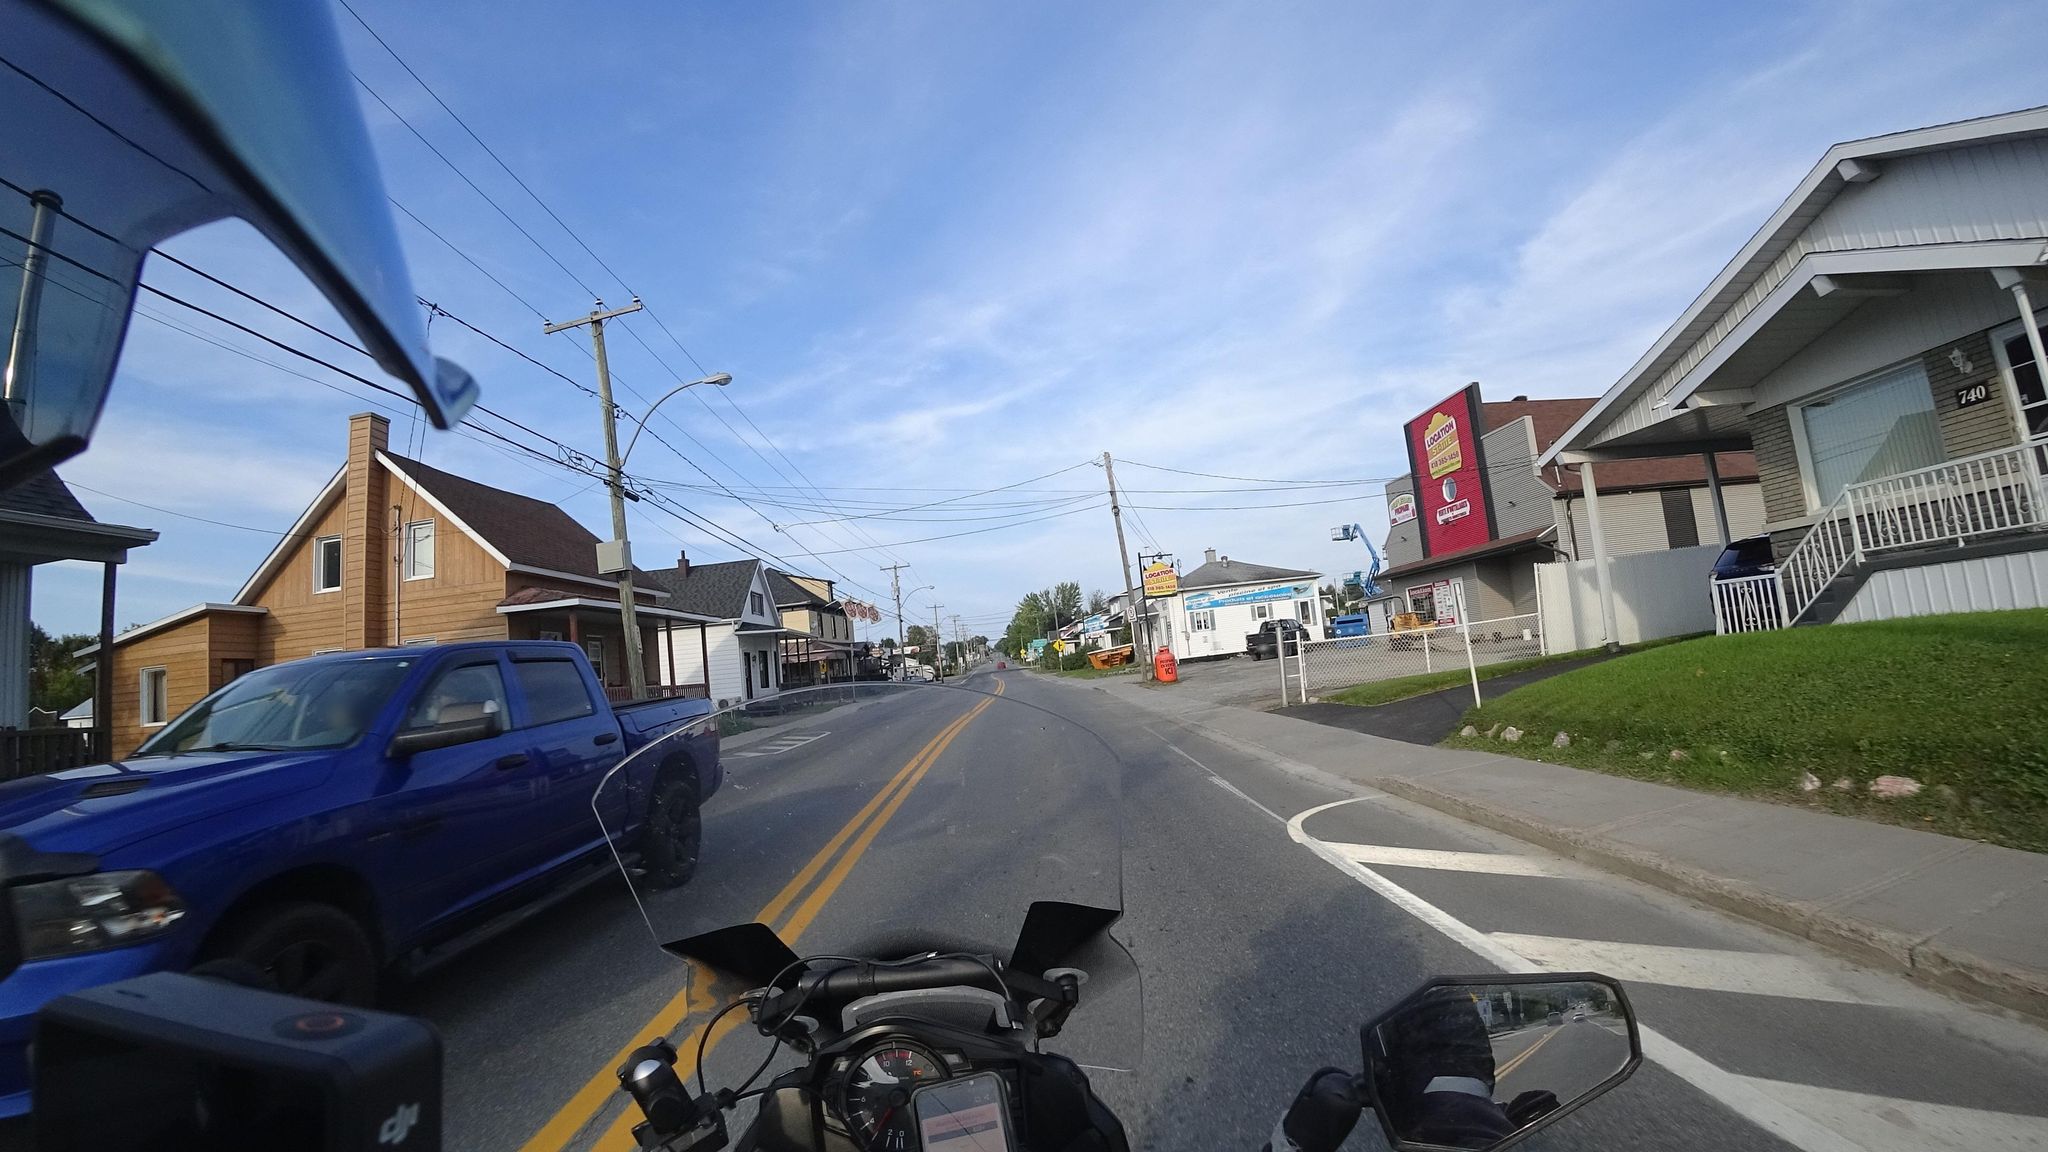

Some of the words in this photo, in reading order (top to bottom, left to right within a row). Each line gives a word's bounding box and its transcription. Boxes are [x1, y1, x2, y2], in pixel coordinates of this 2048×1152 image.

[1958, 385, 1986, 404] 740
[1426, 420, 1454, 448] LOCATION
[1145, 569, 1174, 580] LOCATION
[1217, 587, 1238, 595] Vente
[1410, 587, 1432, 596] location
[1218, 596, 1245, 604] Produits
